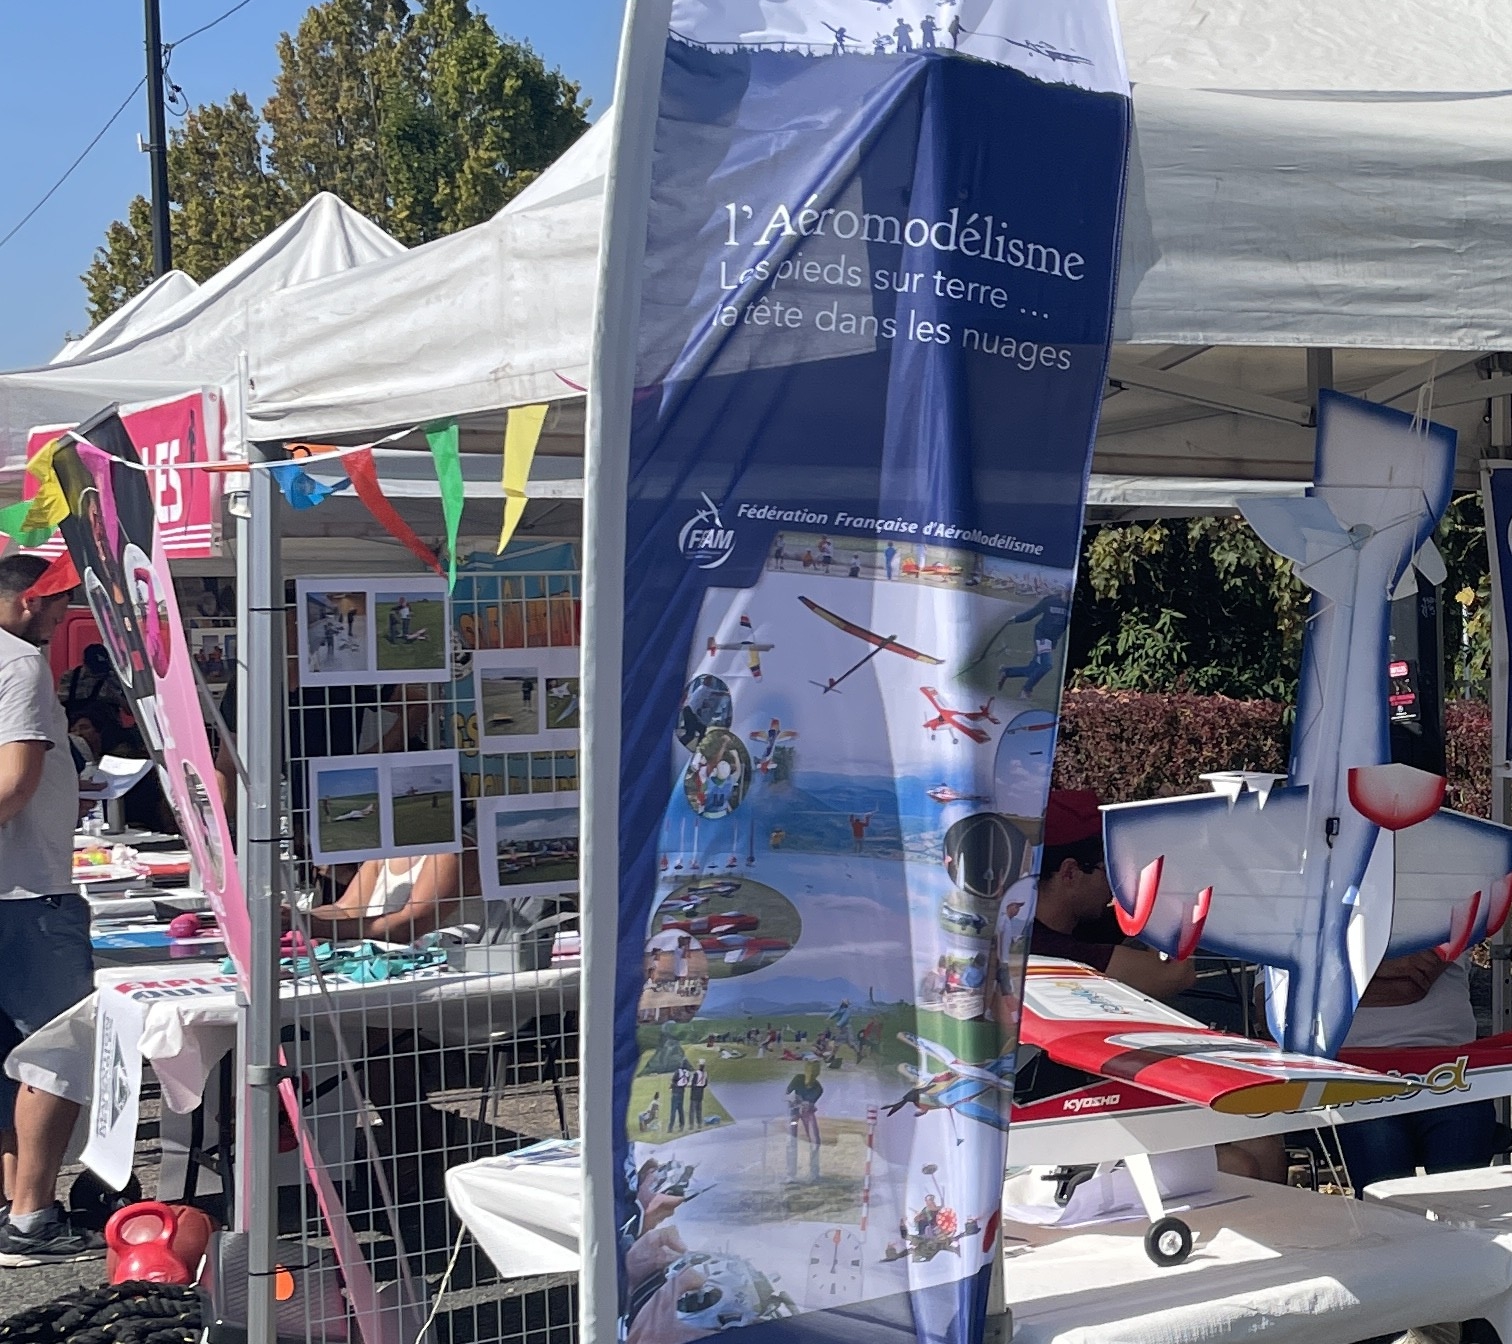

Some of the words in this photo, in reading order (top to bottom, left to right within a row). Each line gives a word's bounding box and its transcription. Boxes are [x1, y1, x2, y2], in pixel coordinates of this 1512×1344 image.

[772, 252, 862, 290] pieds
[874, 266, 925, 293] sur
[932, 269, 1008, 309] terre
[814, 302, 897, 338] dans
[908, 309, 951, 344] les
[962, 327, 1072, 372] nuages
[142, 439, 183, 524] ES
[737, 502, 829, 526] Fédération
[834, 511, 918, 534] Française
[922, 521, 1044, 557] d'AéroModélisme
[1063, 1094, 1121, 1112] KYOSHO
